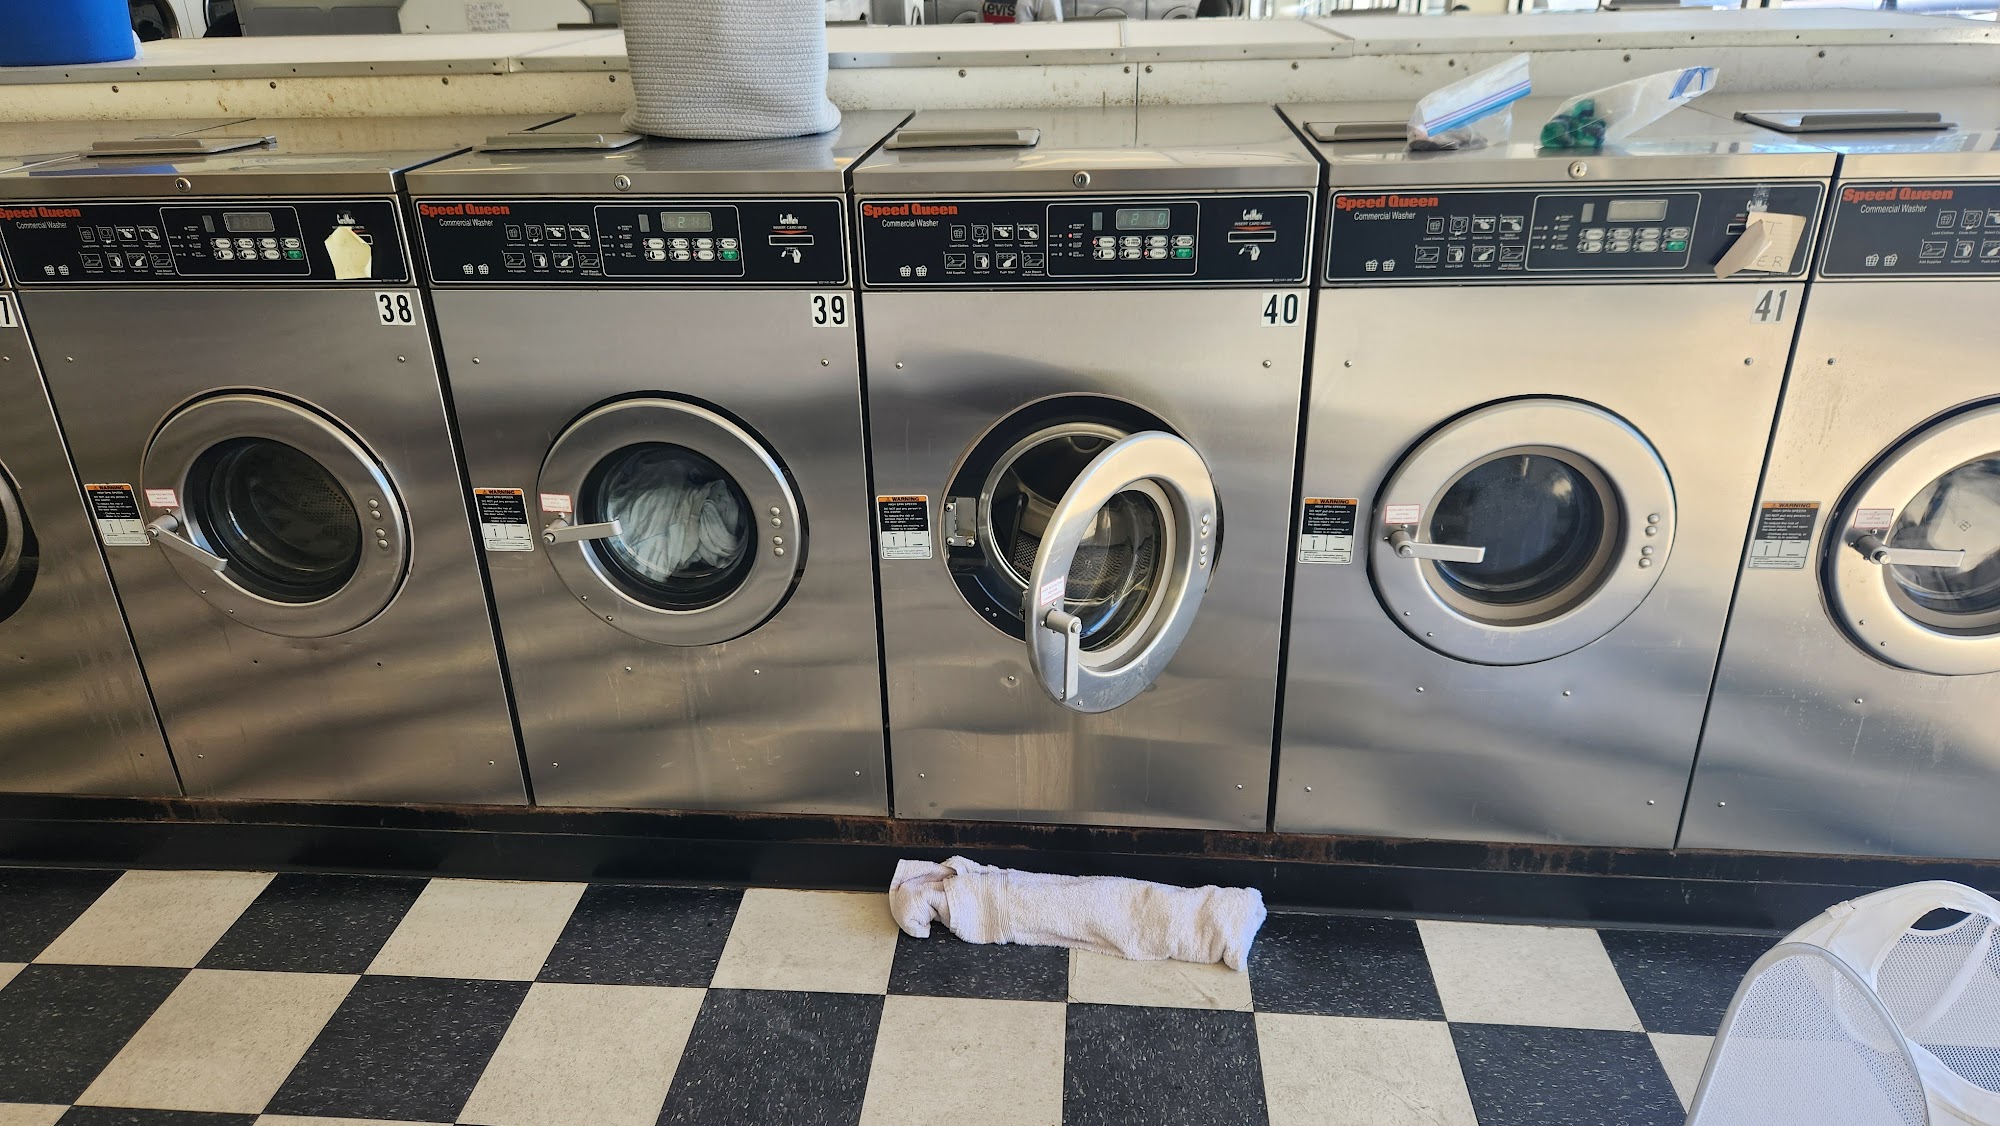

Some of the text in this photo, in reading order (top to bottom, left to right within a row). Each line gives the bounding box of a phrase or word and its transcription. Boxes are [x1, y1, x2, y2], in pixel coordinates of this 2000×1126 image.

[1843, 188, 1954, 203] Speed Queen
[1336, 195, 1439, 211] Speed Queen
[1860, 204, 1928, 214] Commercial Washer
[0, 207, 82, 220] Speed Queen
[420, 204, 510, 217] Speed Queen
[863, 203, 958, 218] Speed Queen
[1354, 212, 1416, 221] Commercial Washer
[16, 222, 46, 230] Commercial
[439, 219, 472, 227] Commercial
[882, 219, 939, 228] Commercial Washer
[380, 294, 412, 322] 38
[814, 296, 845, 324] 39
[1264, 294, 1298, 324] 40
[1754, 290, 1788, 322] 41
